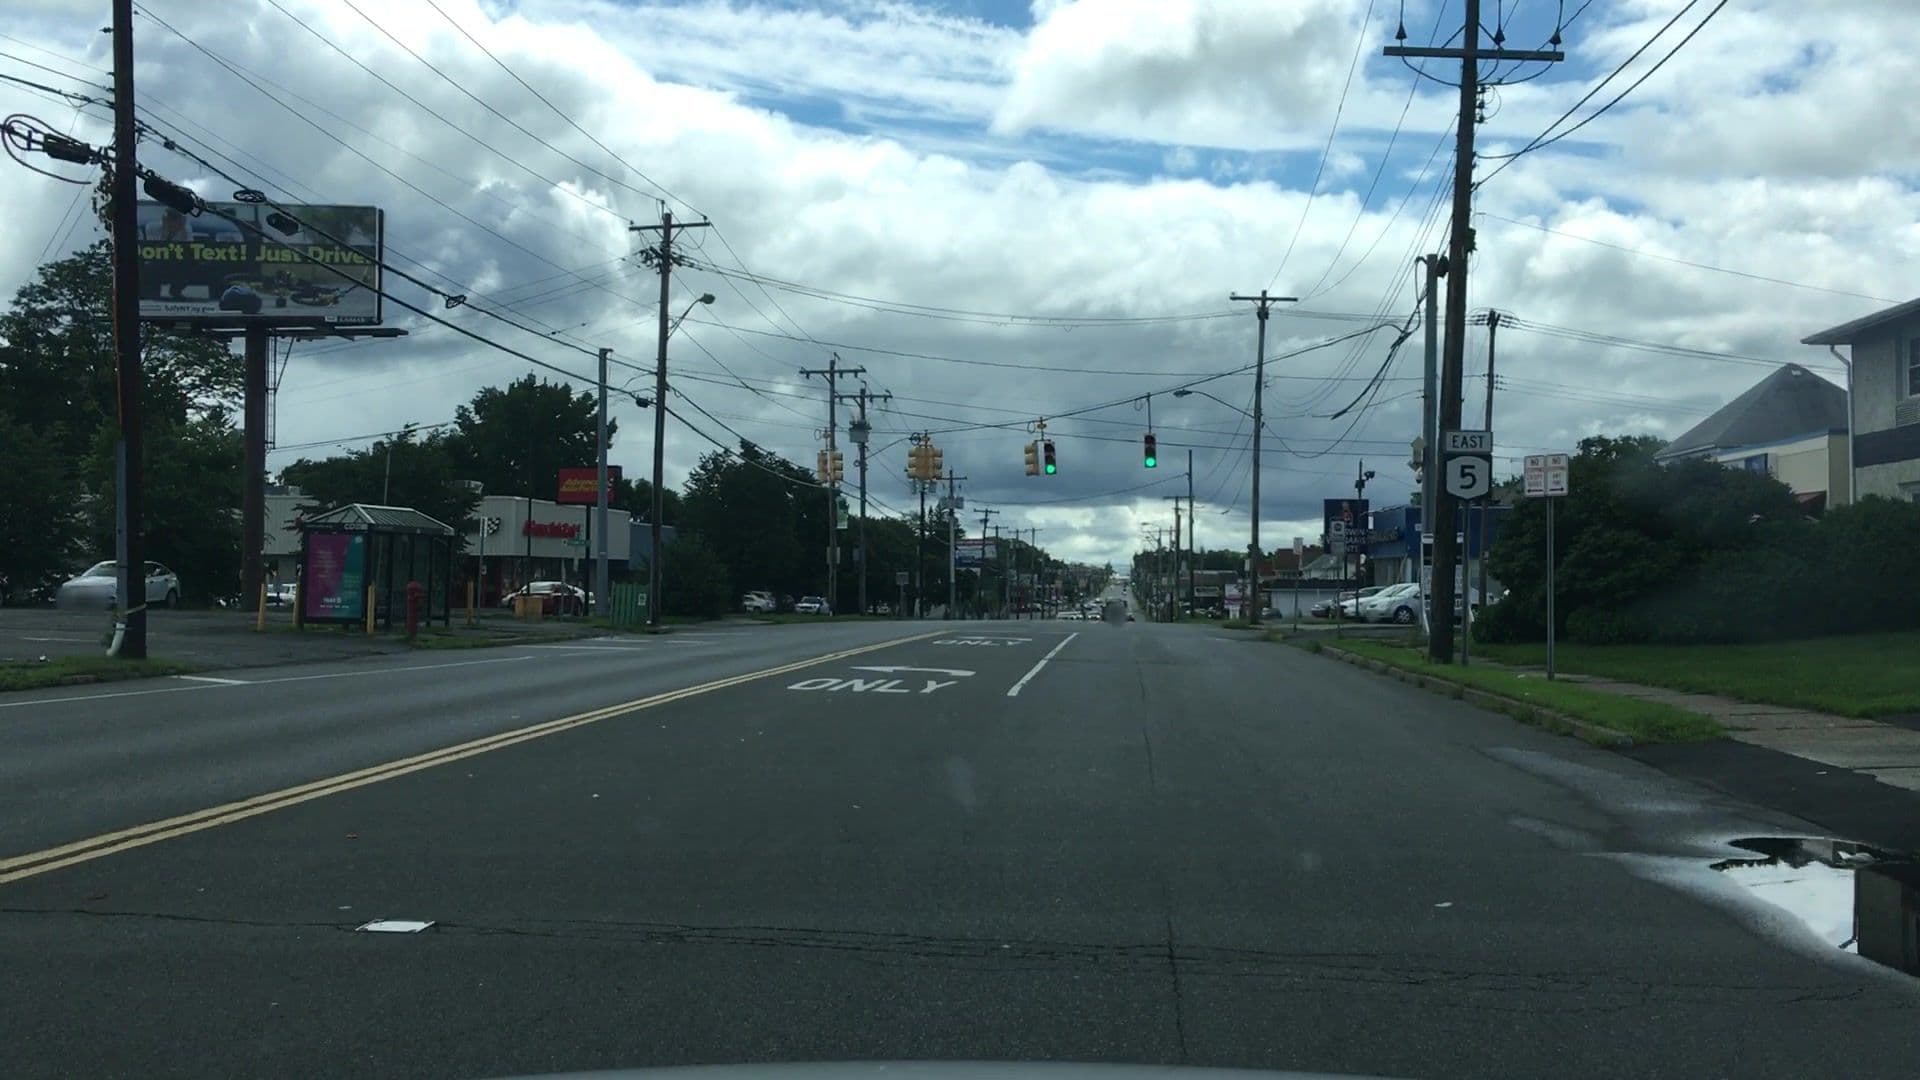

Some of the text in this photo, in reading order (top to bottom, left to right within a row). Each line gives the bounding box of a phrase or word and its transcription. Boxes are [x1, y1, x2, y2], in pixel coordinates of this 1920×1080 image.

[137, 244, 184, 260] on't
[190, 244, 247, 261] Text!
[254, 245, 302, 262] Just
[1452, 434, 1487, 449] EAST
[1460, 465, 1476, 489] 5
[932, 639, 1023, 647] ONLY
[787, 678, 959, 693] ONLY
